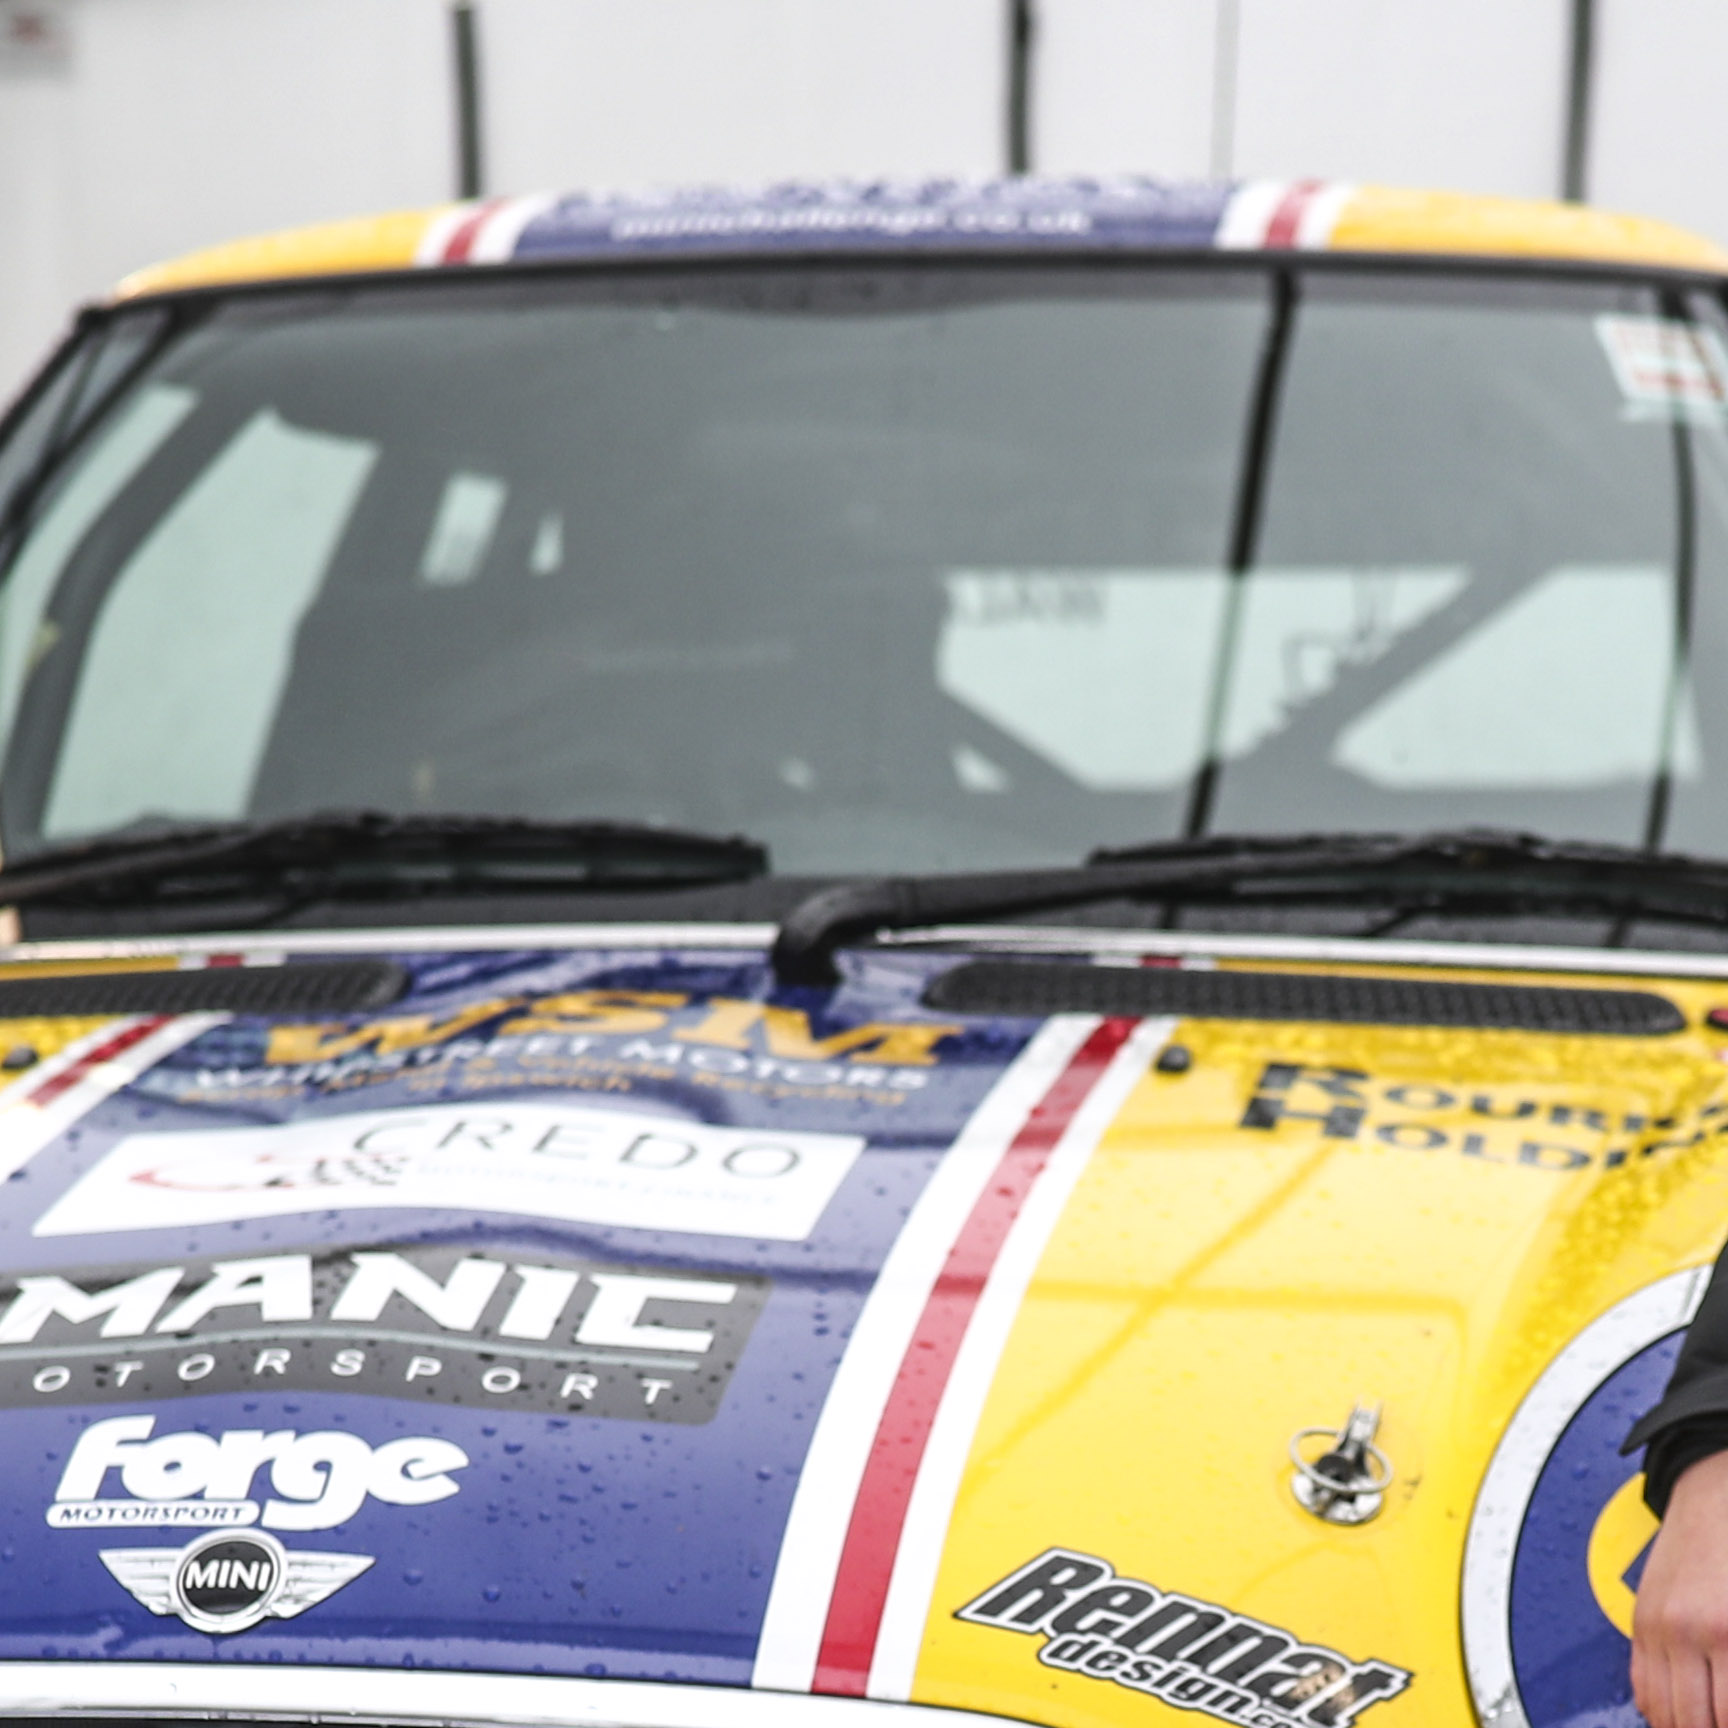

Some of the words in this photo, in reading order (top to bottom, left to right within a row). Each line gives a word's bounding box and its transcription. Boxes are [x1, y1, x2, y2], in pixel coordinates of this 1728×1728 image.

[352, 1118, 802, 1180] CREDO
[60, 1506, 246, 1521] MOTORSPORT
[186, 1560, 271, 1591] MINI
